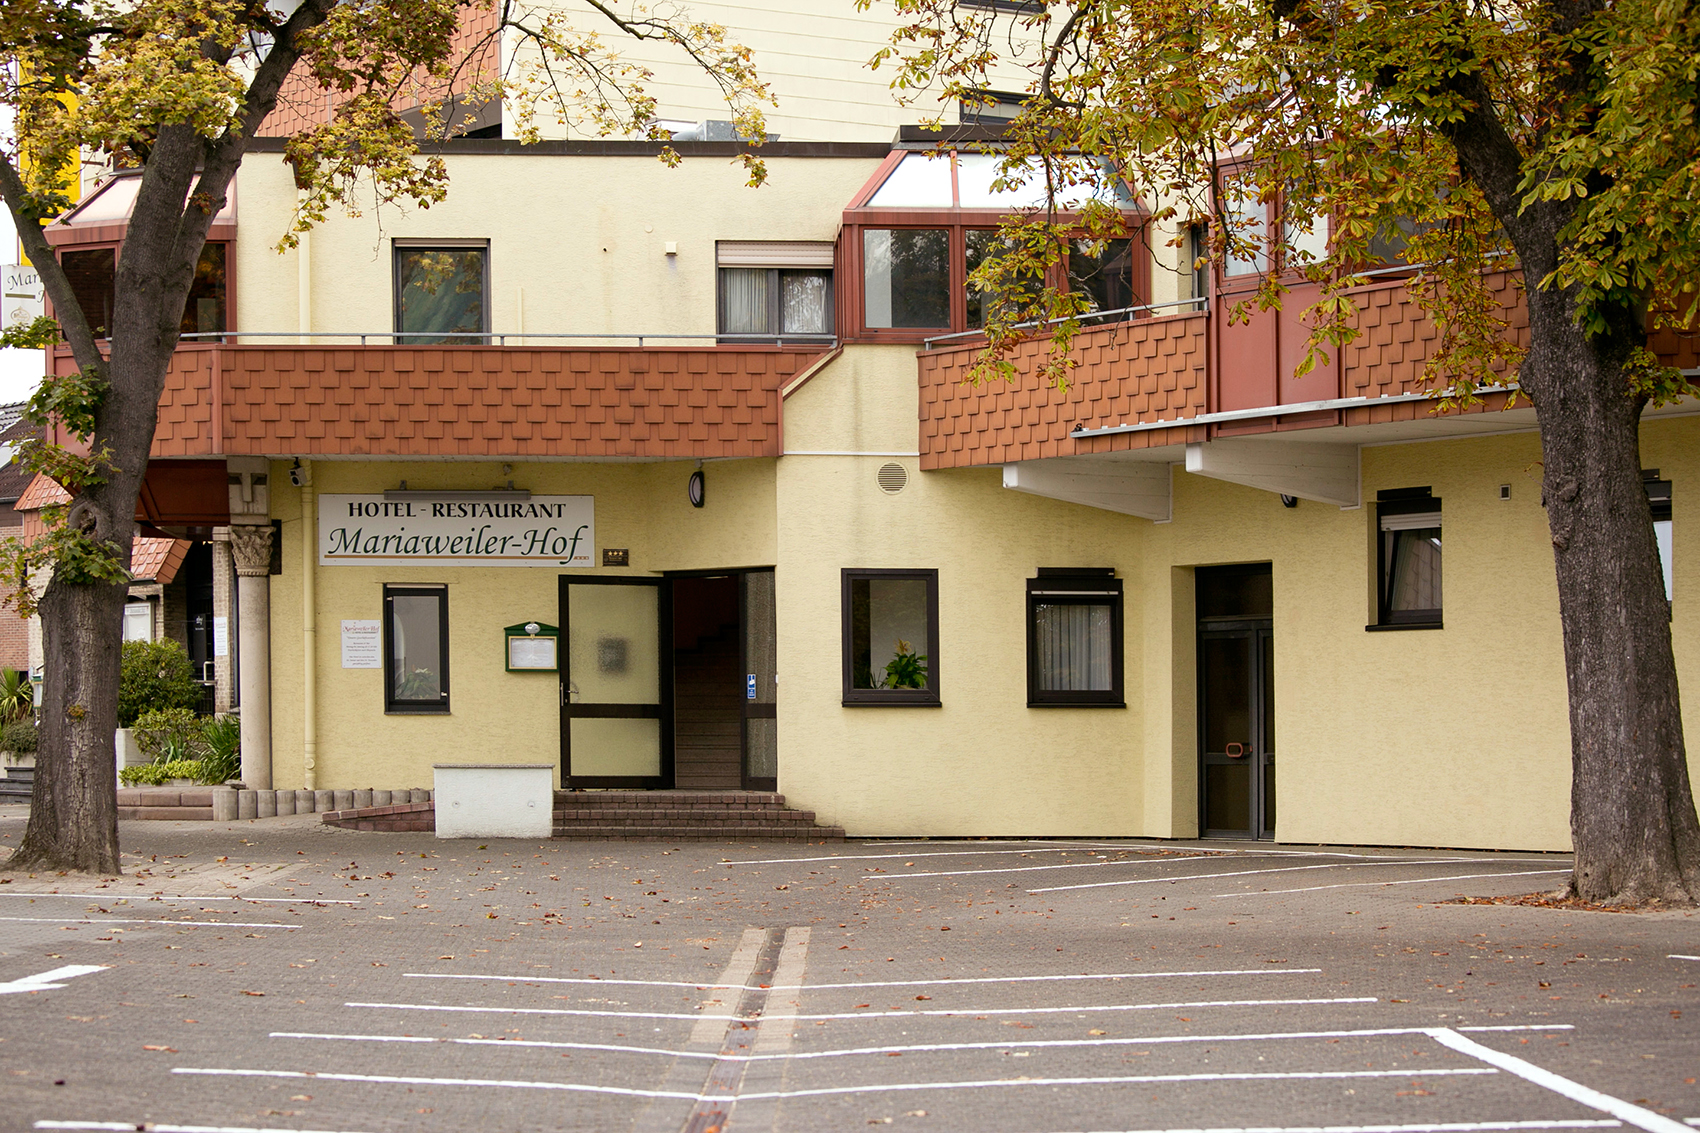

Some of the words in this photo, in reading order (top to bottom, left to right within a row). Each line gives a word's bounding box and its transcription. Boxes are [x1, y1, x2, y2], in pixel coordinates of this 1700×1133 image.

[348, 502, 417, 518] HOTEL
[432, 502, 567, 519] RESTAURANT
[328, 525, 589, 565] Mariaweiler-Hof
